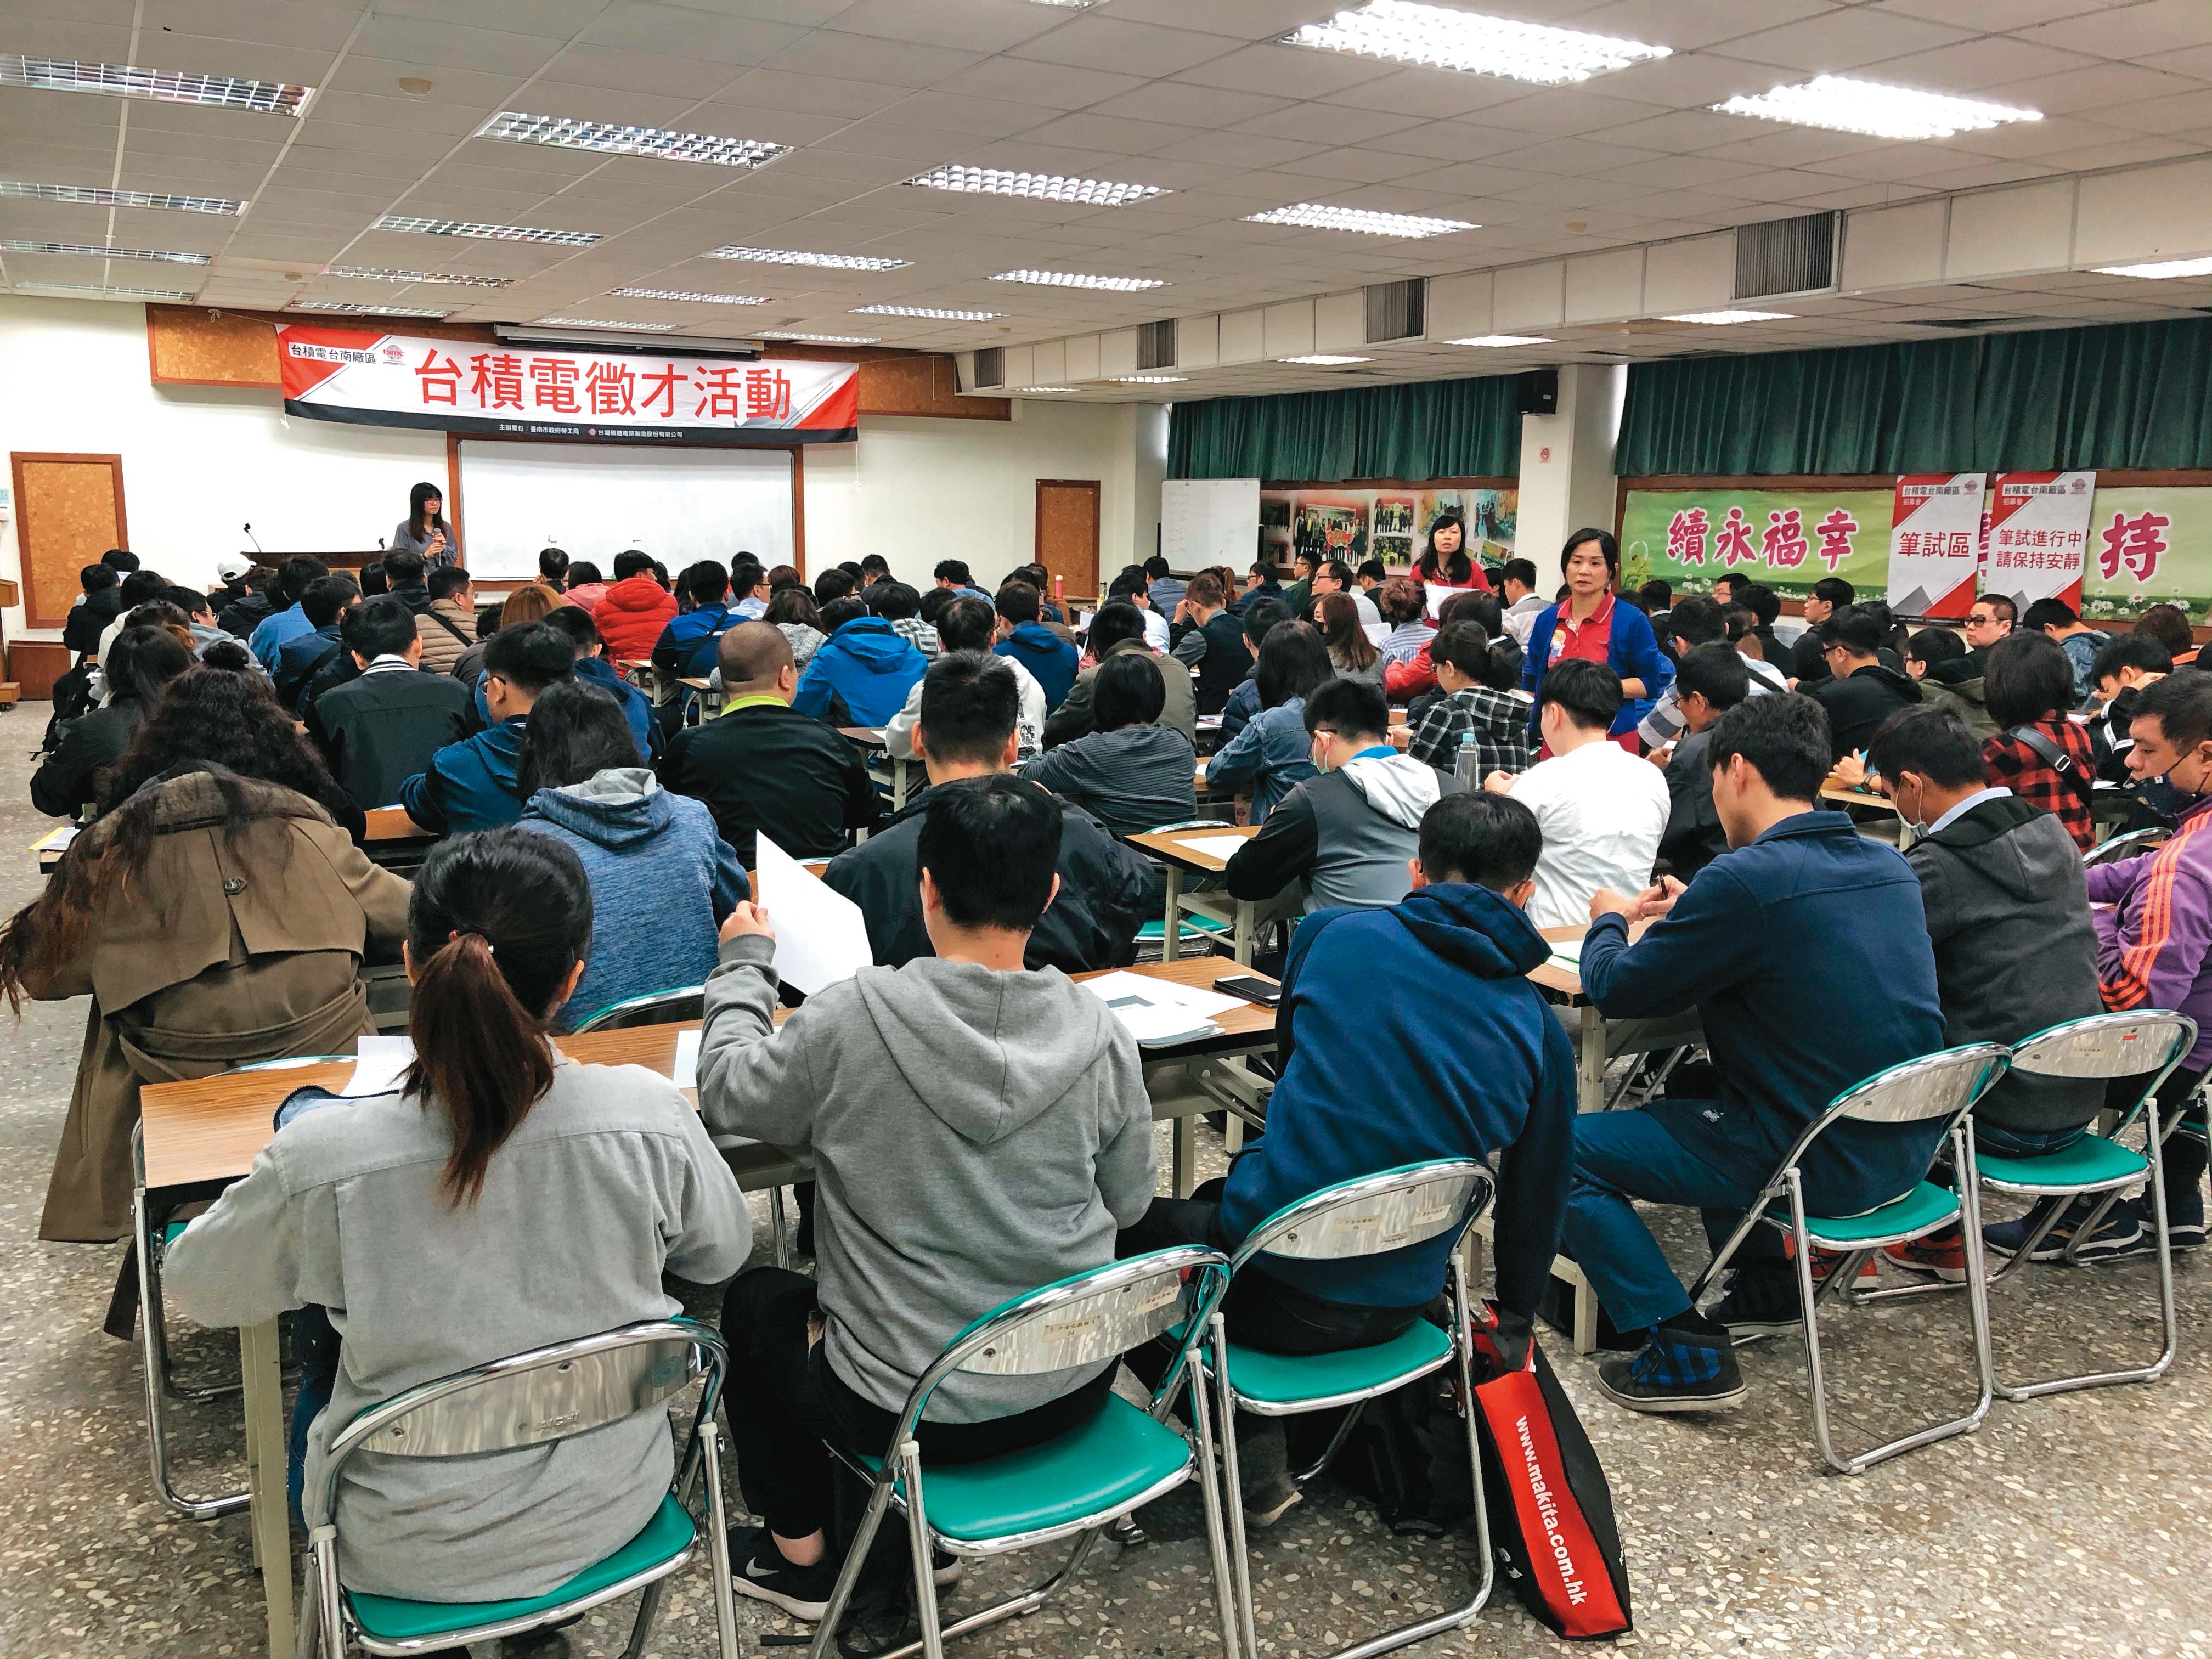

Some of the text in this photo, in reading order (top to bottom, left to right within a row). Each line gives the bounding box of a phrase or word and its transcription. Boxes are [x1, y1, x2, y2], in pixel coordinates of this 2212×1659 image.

[291, 344, 377, 364] 台積電台南廠區
[414, 348, 791, 420] 台積電徵才活動
[1898, 531, 1972, 558] 筆試區
[1998, 529, 2082, 548] 筆試進行中
[2100, 512, 2170, 582] 持
[1996, 551, 2080, 571] 請保持安靜
[1516, 1415, 1588, 1606] www.makita.com.hk
